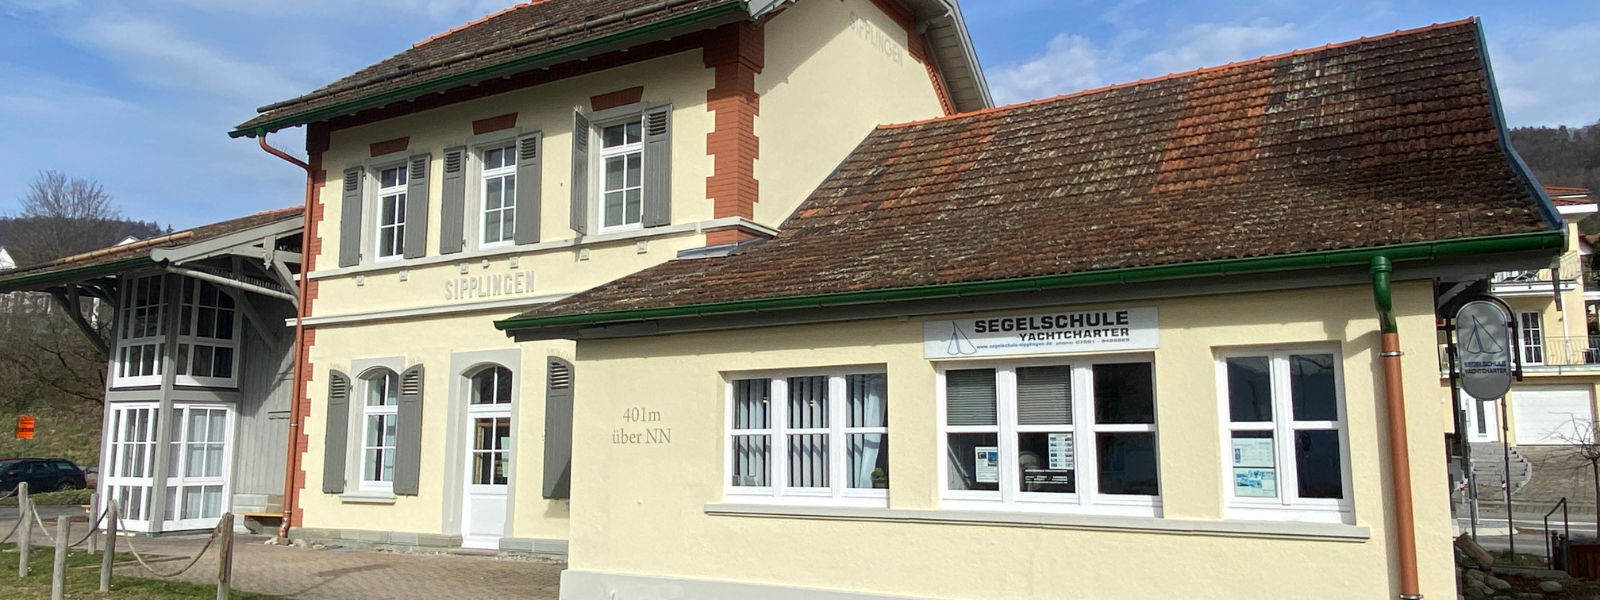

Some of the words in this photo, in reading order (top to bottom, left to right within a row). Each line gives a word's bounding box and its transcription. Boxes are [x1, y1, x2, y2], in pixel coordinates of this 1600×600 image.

[850, 10, 902, 67] SIPPLINGEN
[445, 271, 534, 300] SIPPLINGEN
[974, 311, 1129, 333] SEGELSCHULE
[1019, 328, 1129, 342] YACHTCHARTER
[623, 407, 661, 422] 401m
[612, 428, 642, 444] über
[645, 428, 671, 444] NN
